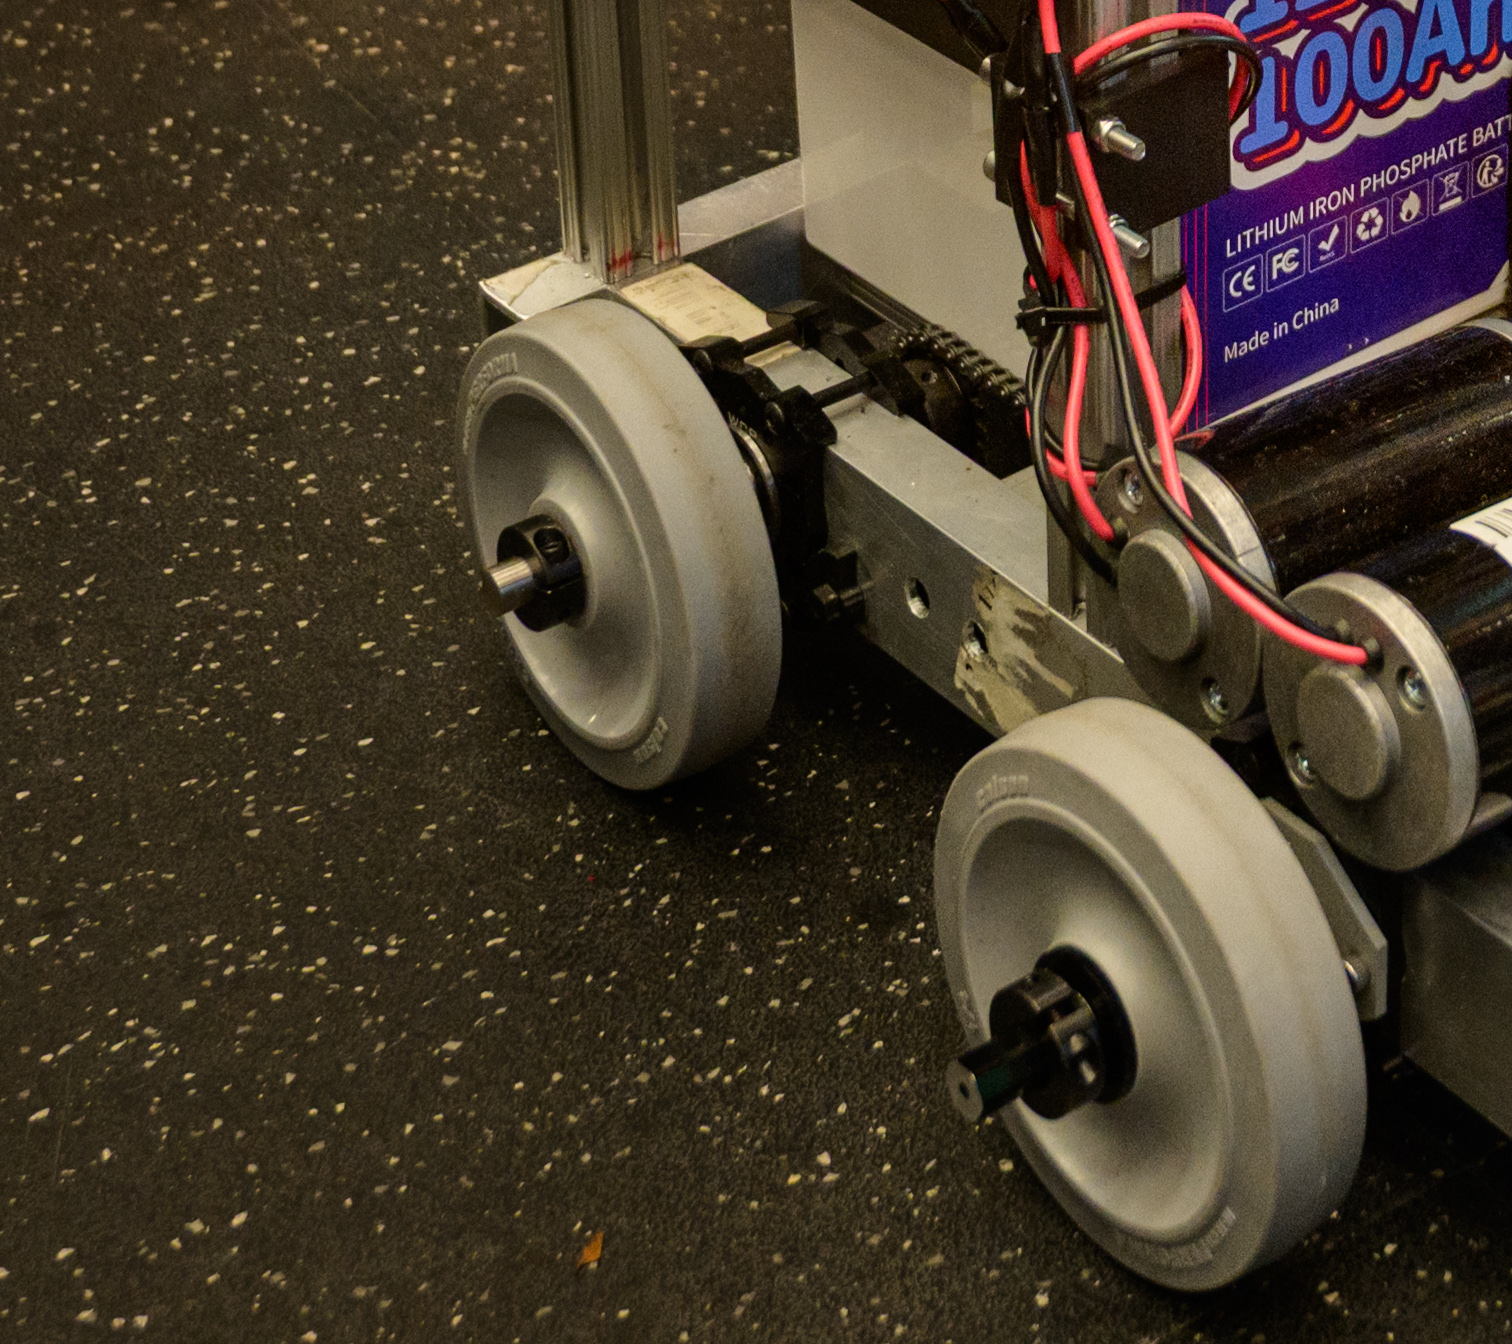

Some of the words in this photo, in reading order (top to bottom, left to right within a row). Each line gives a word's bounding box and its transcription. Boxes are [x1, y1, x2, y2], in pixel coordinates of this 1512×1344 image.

[1226, 210, 1304, 258] LITHIUM
[1309, 183, 1355, 220] IRON
[1360, 134, 1468, 197] PHOSPHATE
[1224, 330, 1269, 363] Made
[1273, 321, 1288, 340] in
[1292, 297, 1340, 330] China
